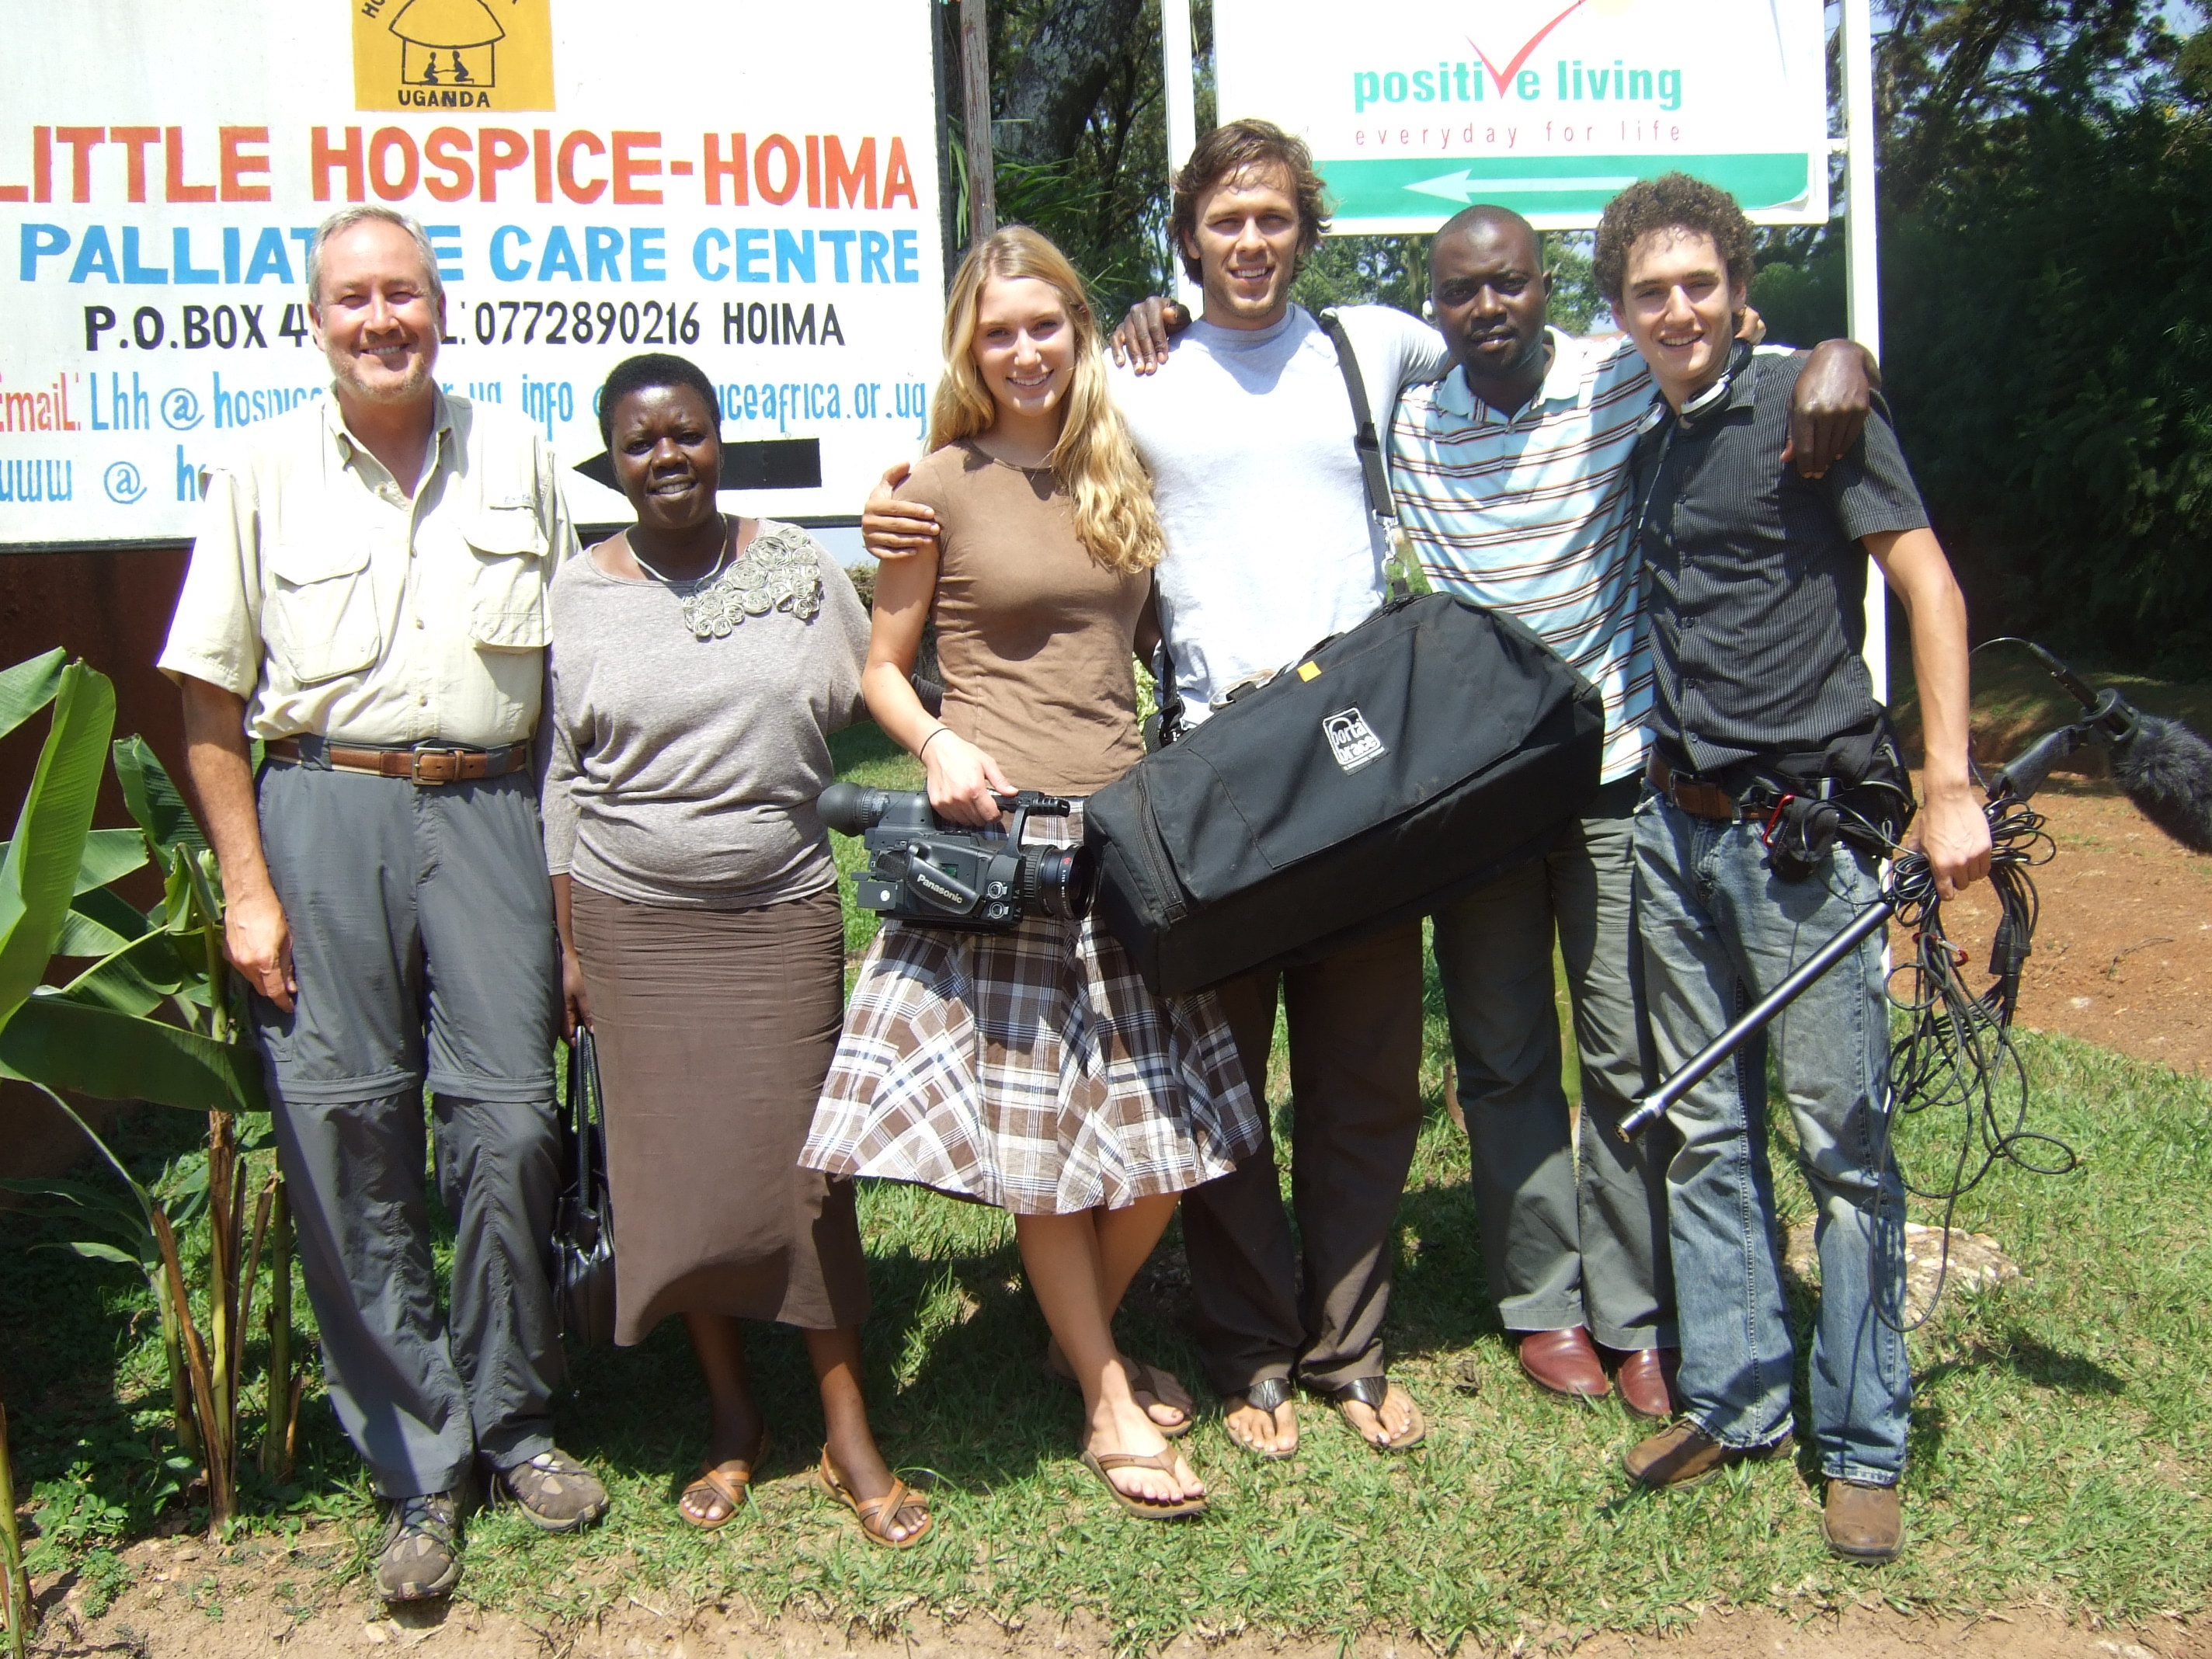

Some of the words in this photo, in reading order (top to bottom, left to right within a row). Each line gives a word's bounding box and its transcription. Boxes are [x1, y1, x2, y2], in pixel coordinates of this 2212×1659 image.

[398, 90, 491, 107] UGANDA
[1557, 60, 1682, 111] living
[1356, 122, 1517, 150] everyday
[1546, 120, 1593, 142] for
[1621, 120, 1680, 141] life
[19, 223, 464, 284] PALLIATE
[489, 225, 666, 282] CARE
[692, 228, 919, 284] CENTRE
[723, 303, 845, 346] HOIMA
[522, 374, 573, 442] info
[916, 873, 963, 904] Panasonic
